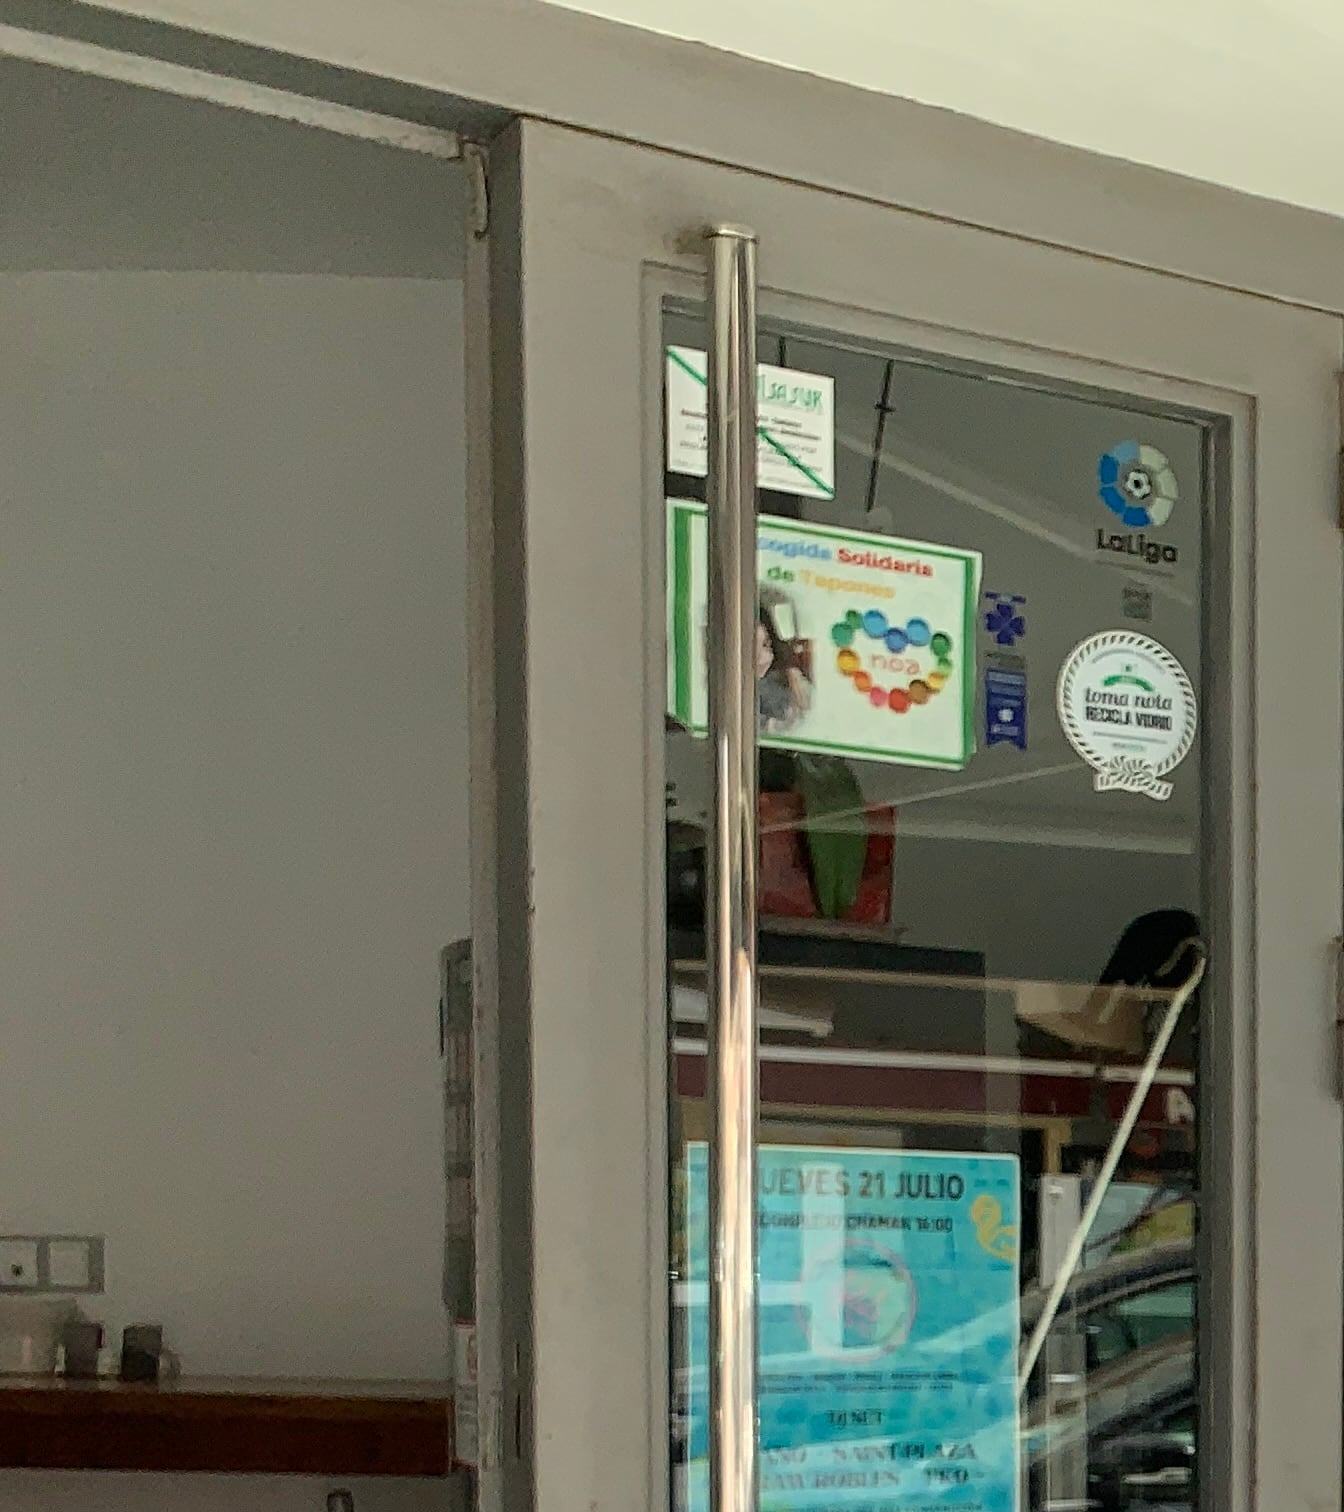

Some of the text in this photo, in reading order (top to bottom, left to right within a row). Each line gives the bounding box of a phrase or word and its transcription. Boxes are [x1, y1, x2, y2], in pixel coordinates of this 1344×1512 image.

[1097, 529, 1178, 563] LaLiga
[767, 566, 795, 583] de
[837, 549, 933, 578] Solidaria
[870, 653, 921, 676] noa
[1085, 687, 1173, 711] toma nota
[1086, 706, 1173, 732] RECICLA VIDRIO
[858, 1170, 886, 1200] 21
[895, 1172, 966, 1202] JULIO
